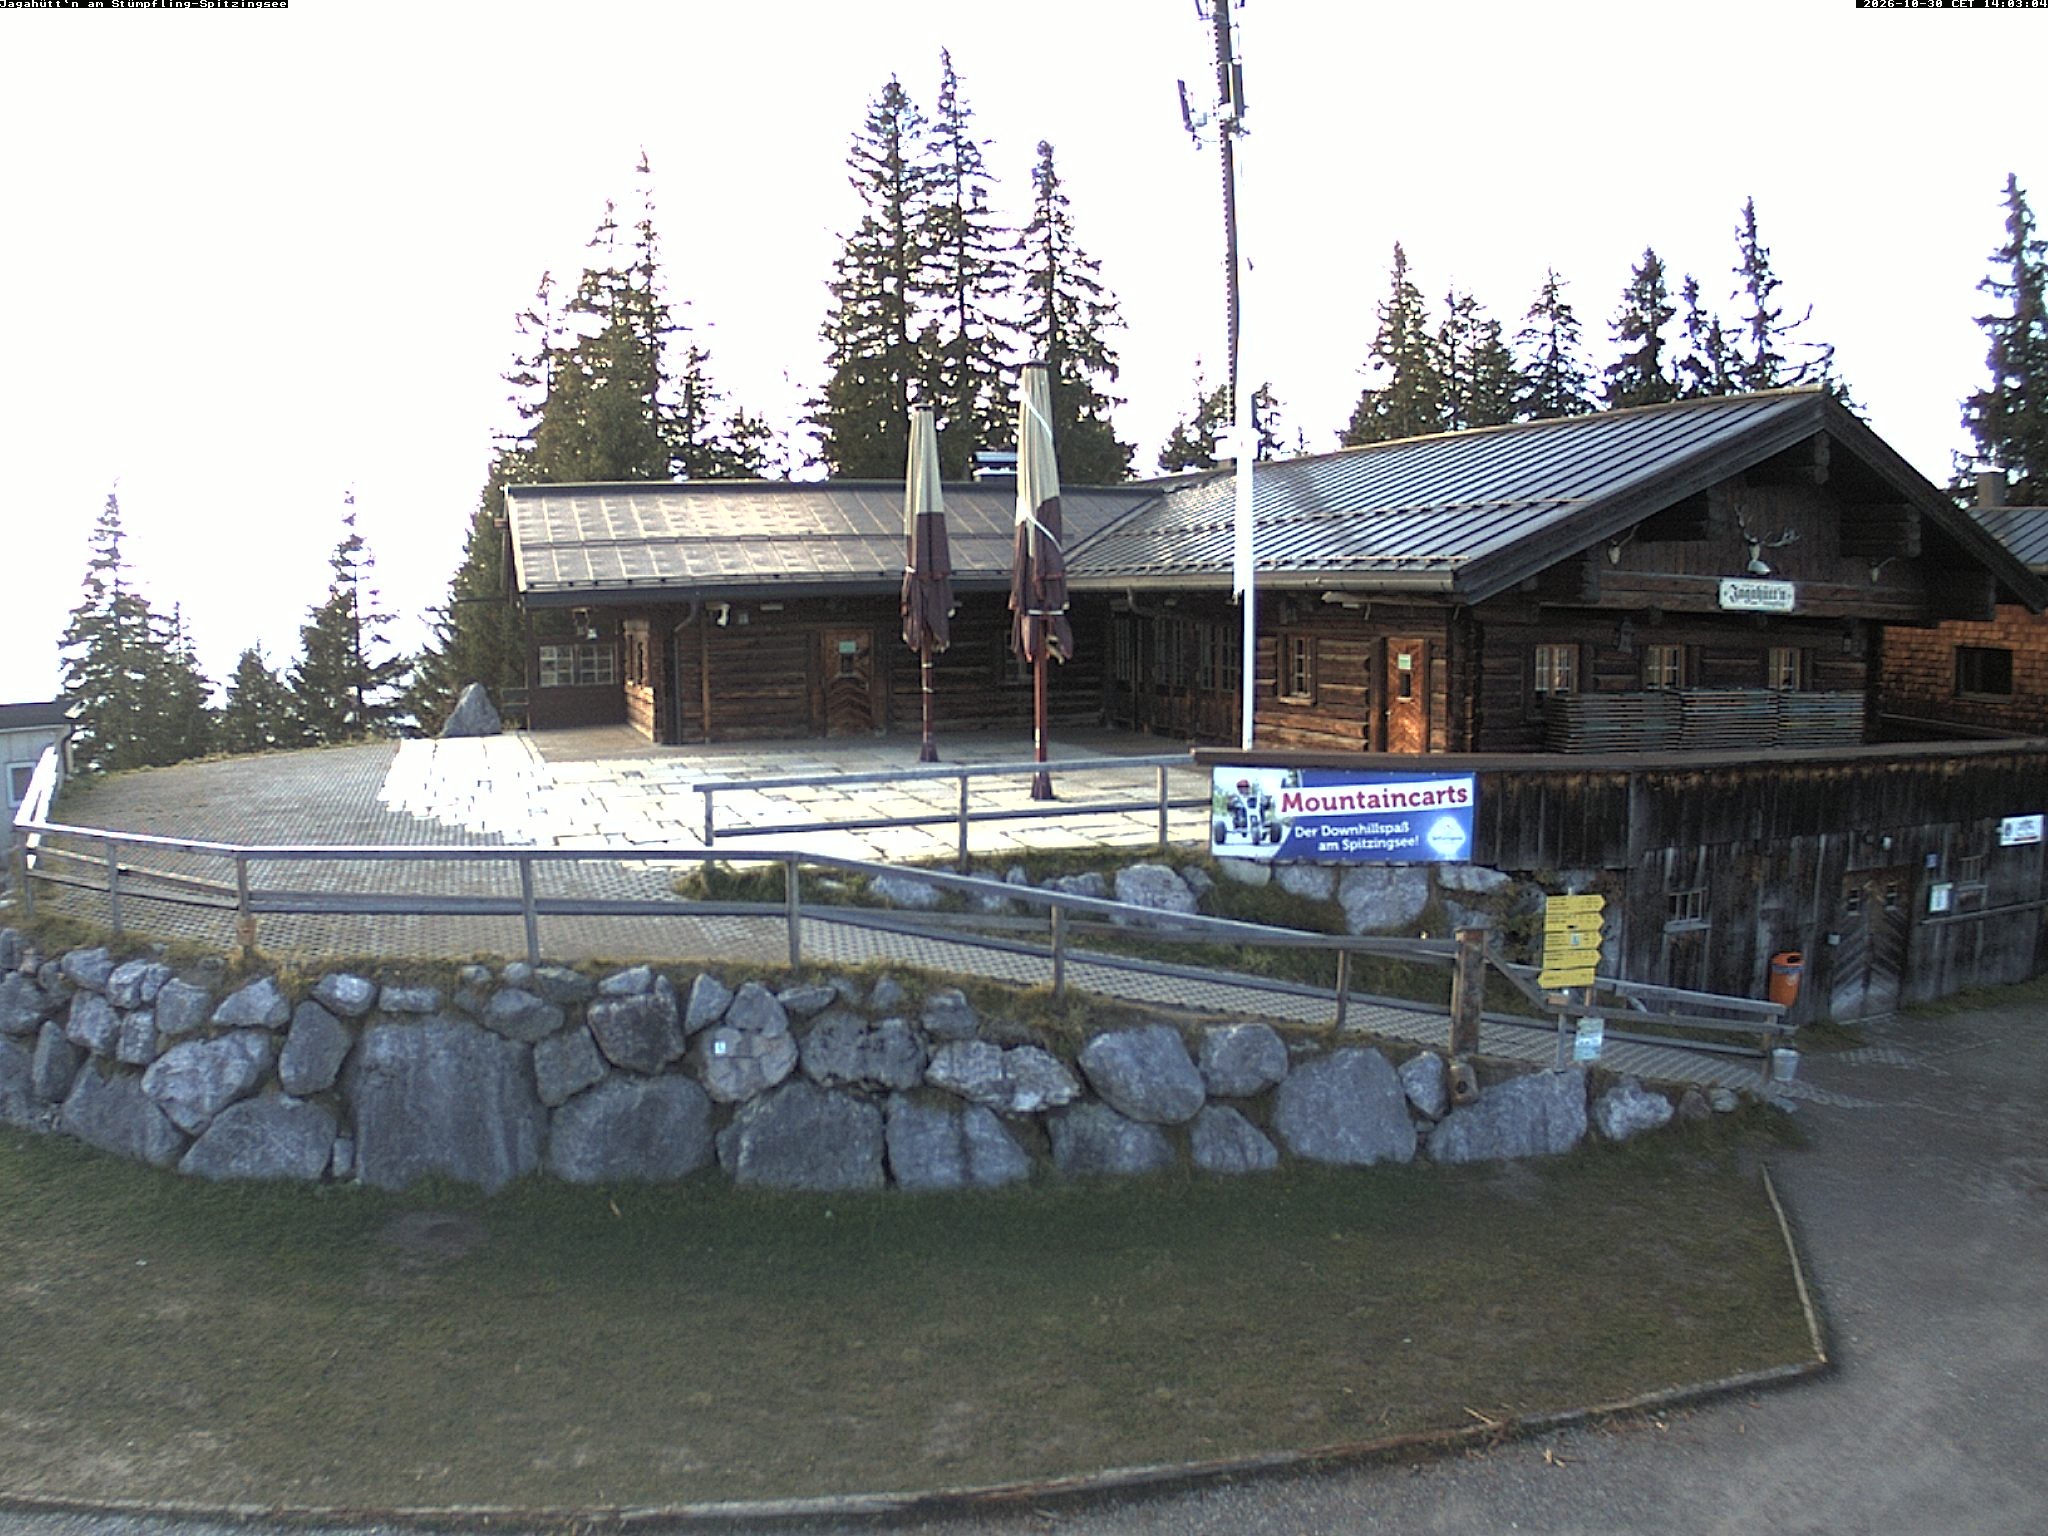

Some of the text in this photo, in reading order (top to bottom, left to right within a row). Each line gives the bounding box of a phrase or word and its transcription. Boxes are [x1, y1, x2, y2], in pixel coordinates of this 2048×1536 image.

[1281, 785, 1469, 813] Mountaincarts
[1295, 821, 1410, 838] Der Downhillspaß
[1318, 841, 1340, 852] am
[1342, 835, 1420, 853] Spitzingsee!
